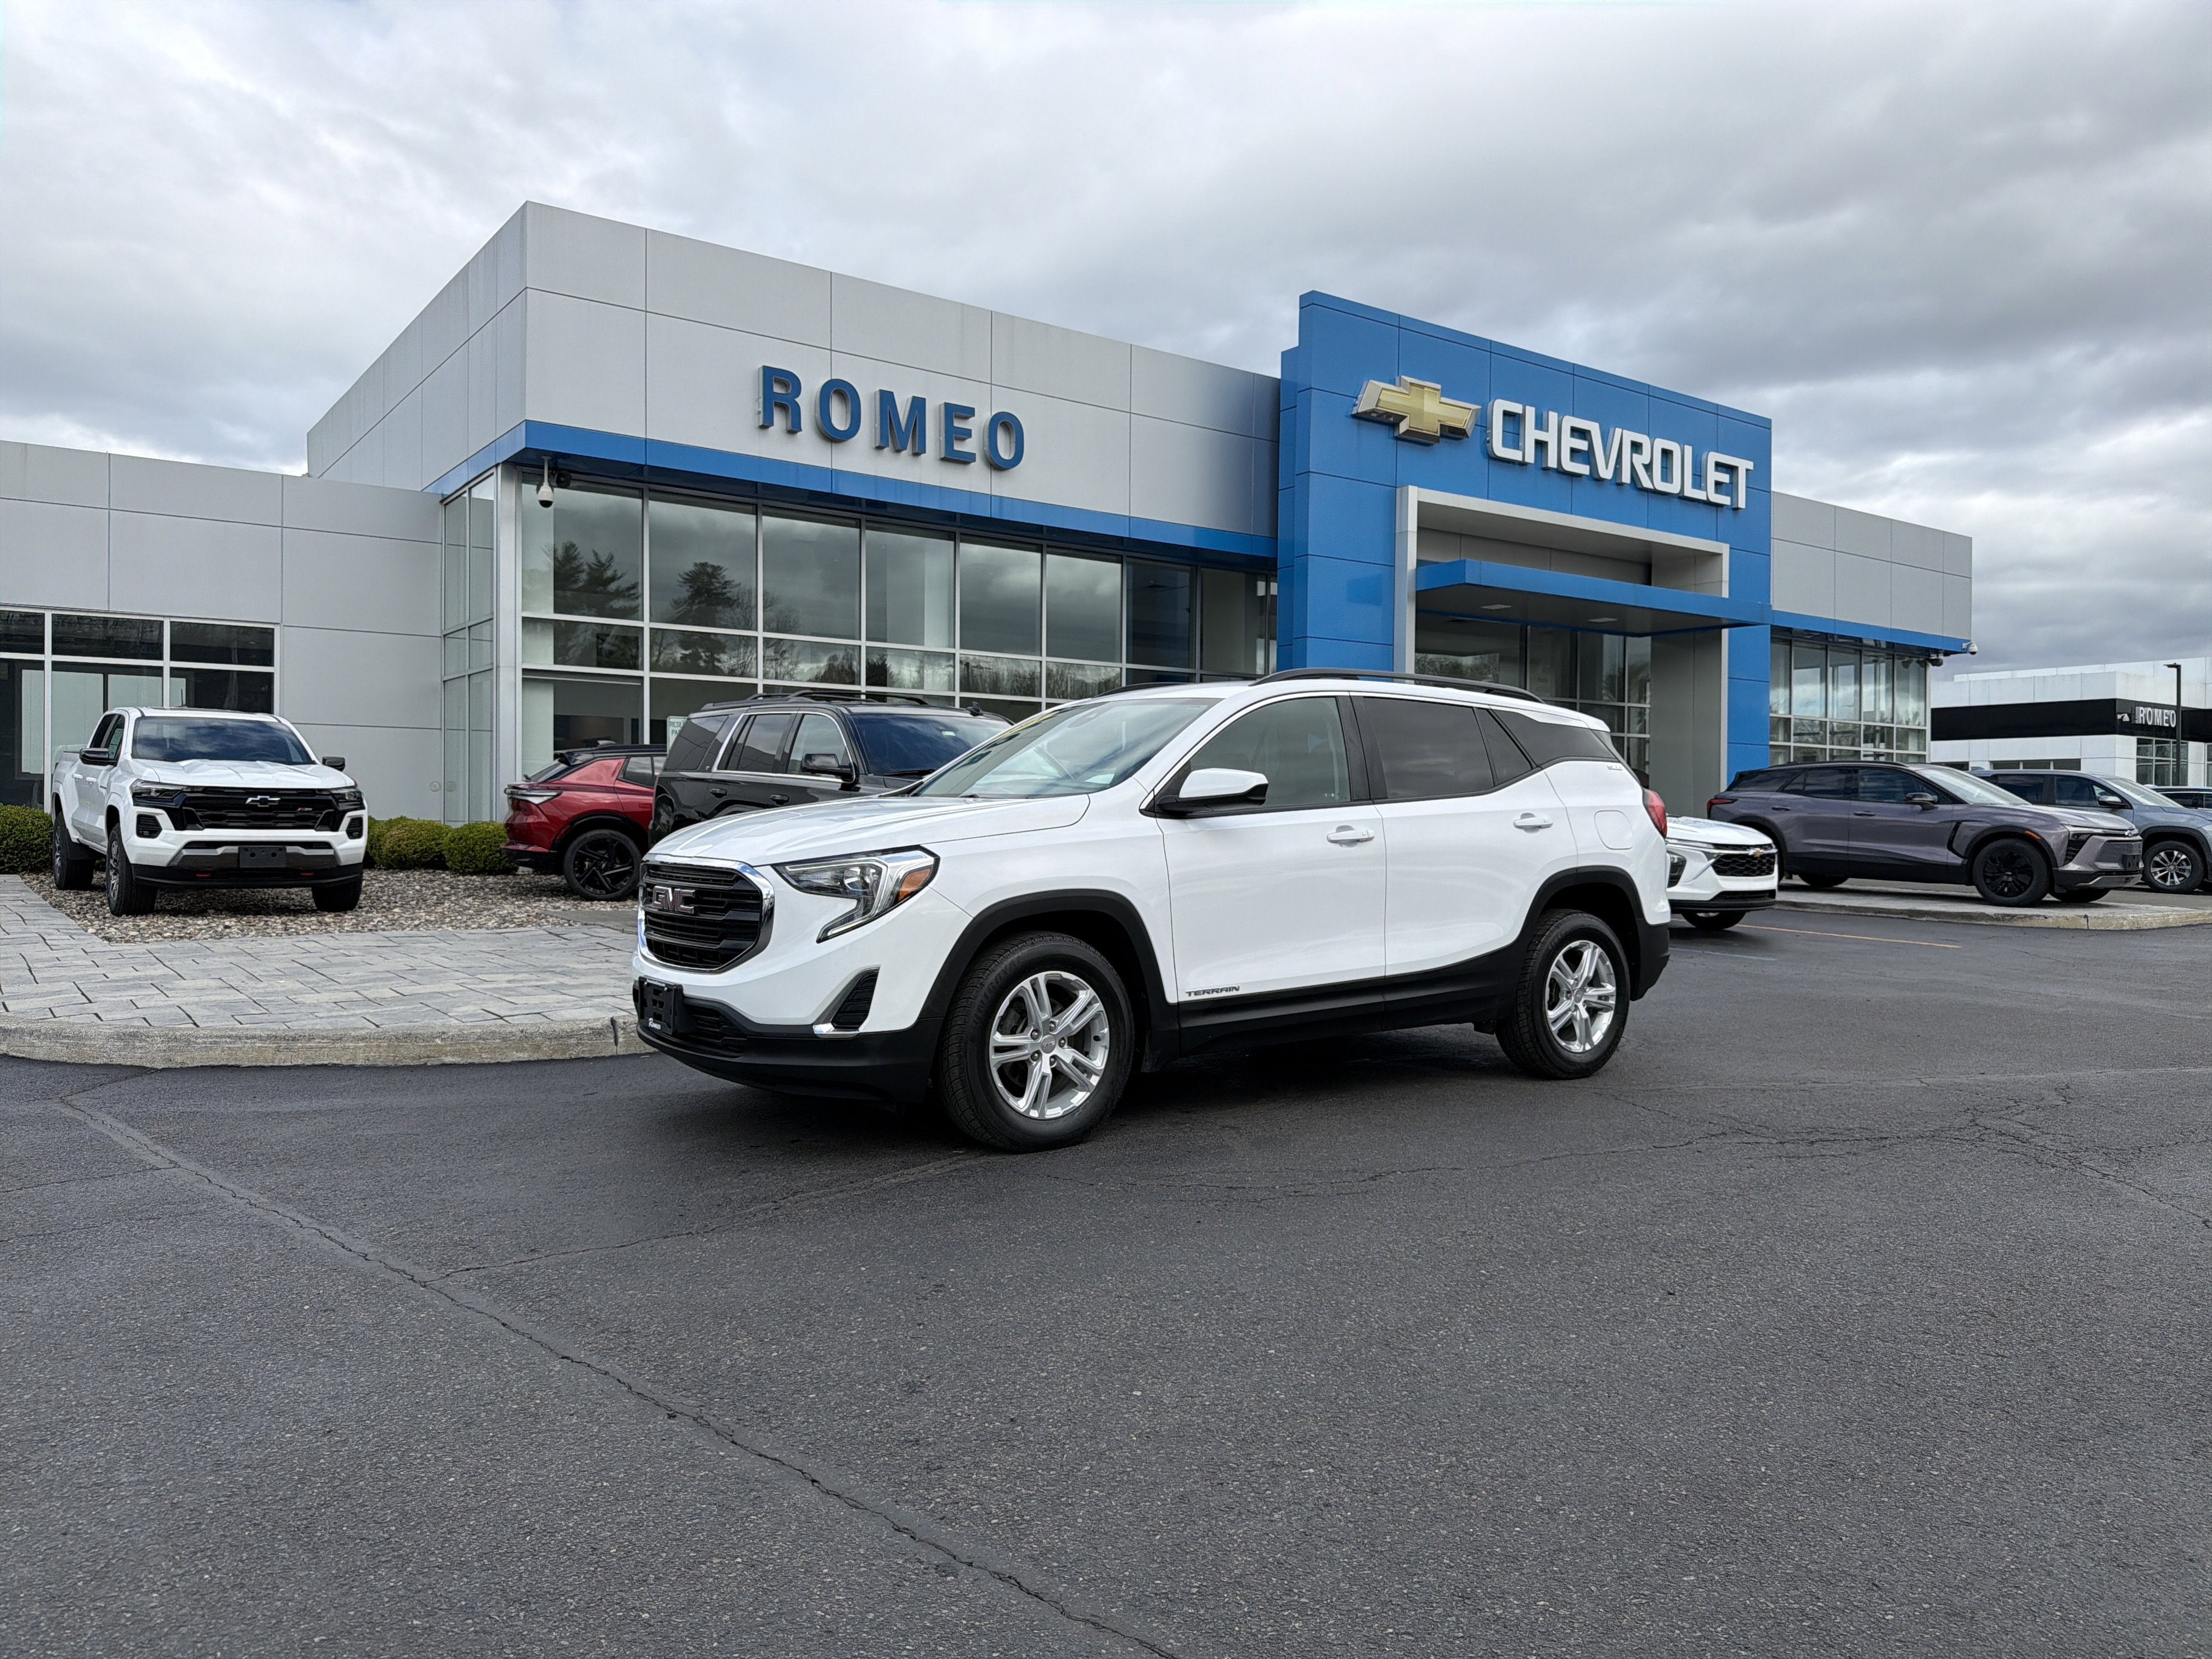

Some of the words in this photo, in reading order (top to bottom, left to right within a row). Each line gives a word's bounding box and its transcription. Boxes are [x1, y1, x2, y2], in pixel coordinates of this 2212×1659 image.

[758, 364, 1024, 471] ROMEO
[1487, 398, 1754, 510] CHEVROLET
[2136, 706, 2176, 728] ROMEO
[652, 885, 695, 914] GMC
[1185, 985, 1240, 997] TERRAIN
